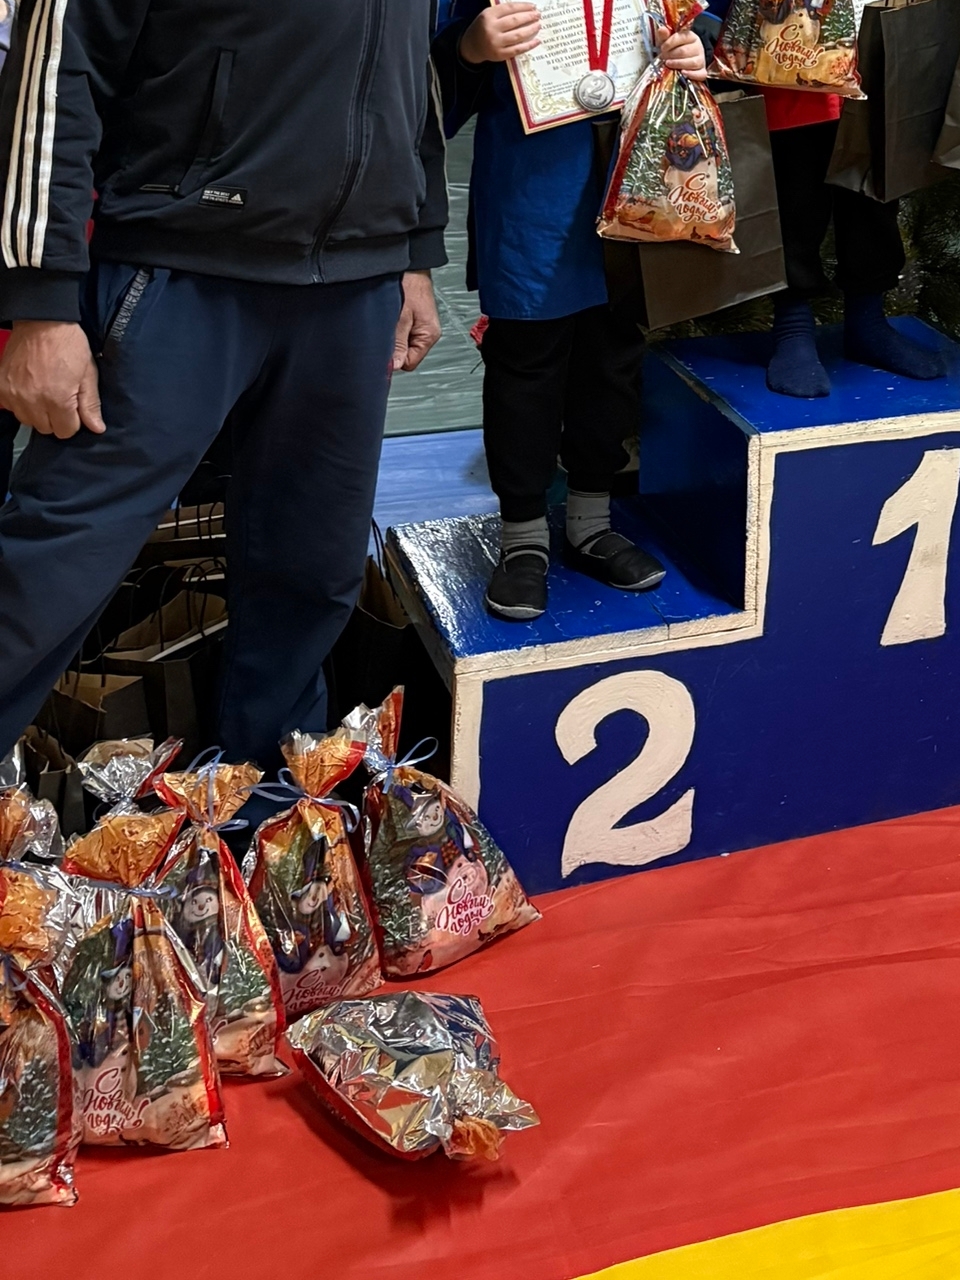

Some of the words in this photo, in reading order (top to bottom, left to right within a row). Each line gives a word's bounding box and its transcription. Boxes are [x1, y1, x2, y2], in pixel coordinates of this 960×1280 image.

[780, 24, 799, 41] С
[587, 77, 606, 101] 2
[684, 172, 706, 191] С
[554, 669, 696, 878] 2
[447, 878, 467, 905] С
[296, 969, 321, 989] С
[95, 1067, 121, 1095] С
